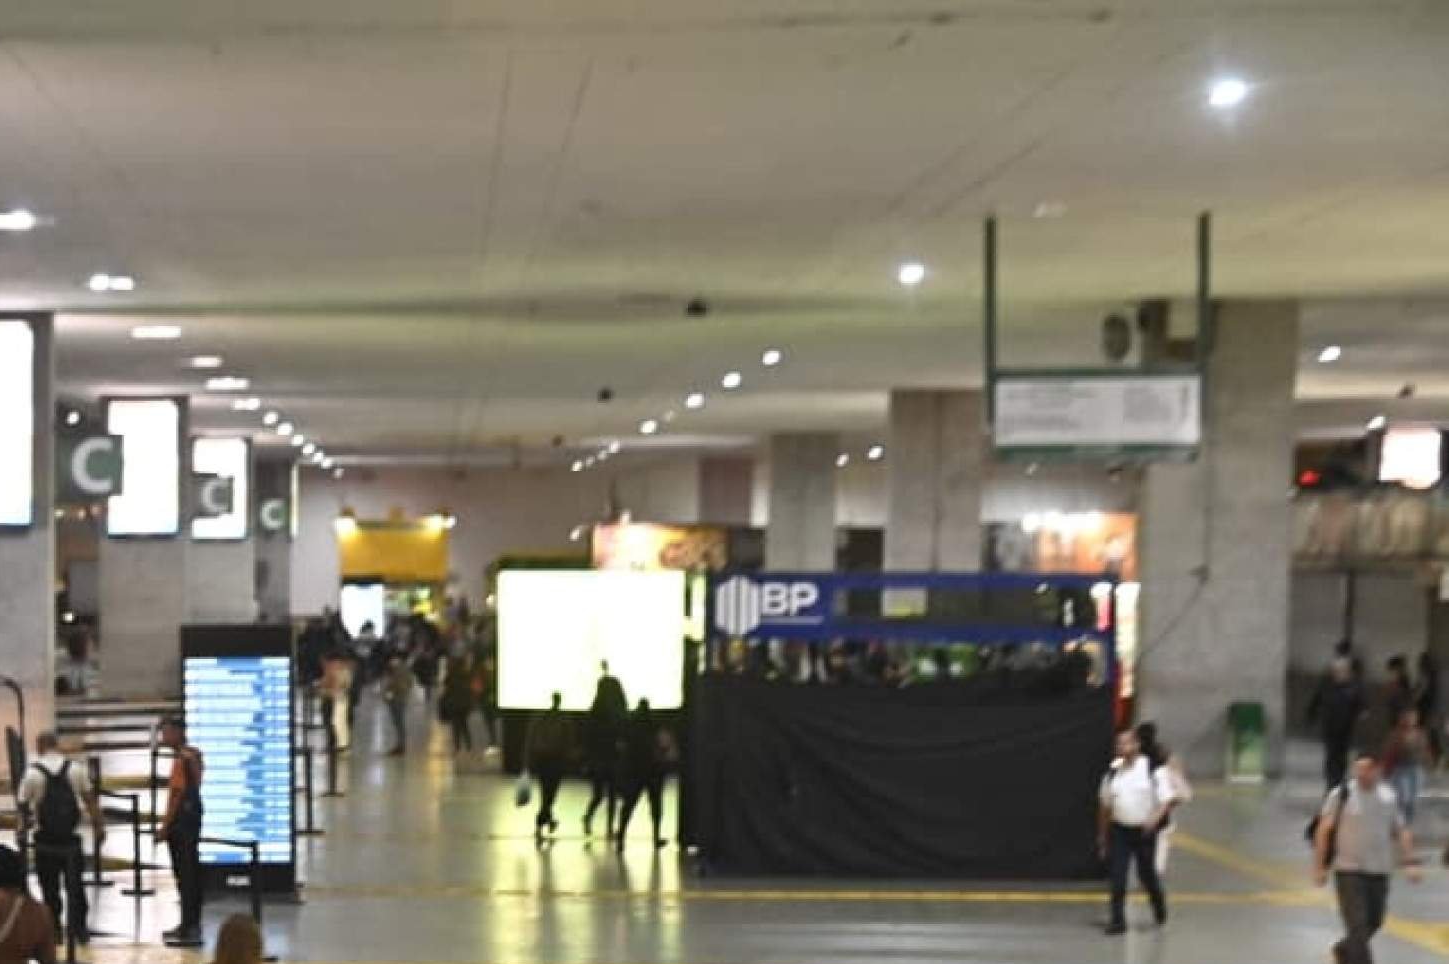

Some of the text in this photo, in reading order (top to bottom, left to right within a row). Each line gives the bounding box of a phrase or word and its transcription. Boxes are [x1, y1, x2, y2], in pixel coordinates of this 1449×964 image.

[71, 437, 114, 494] C
[202, 479, 229, 514] C
[261, 500, 286, 530] C
